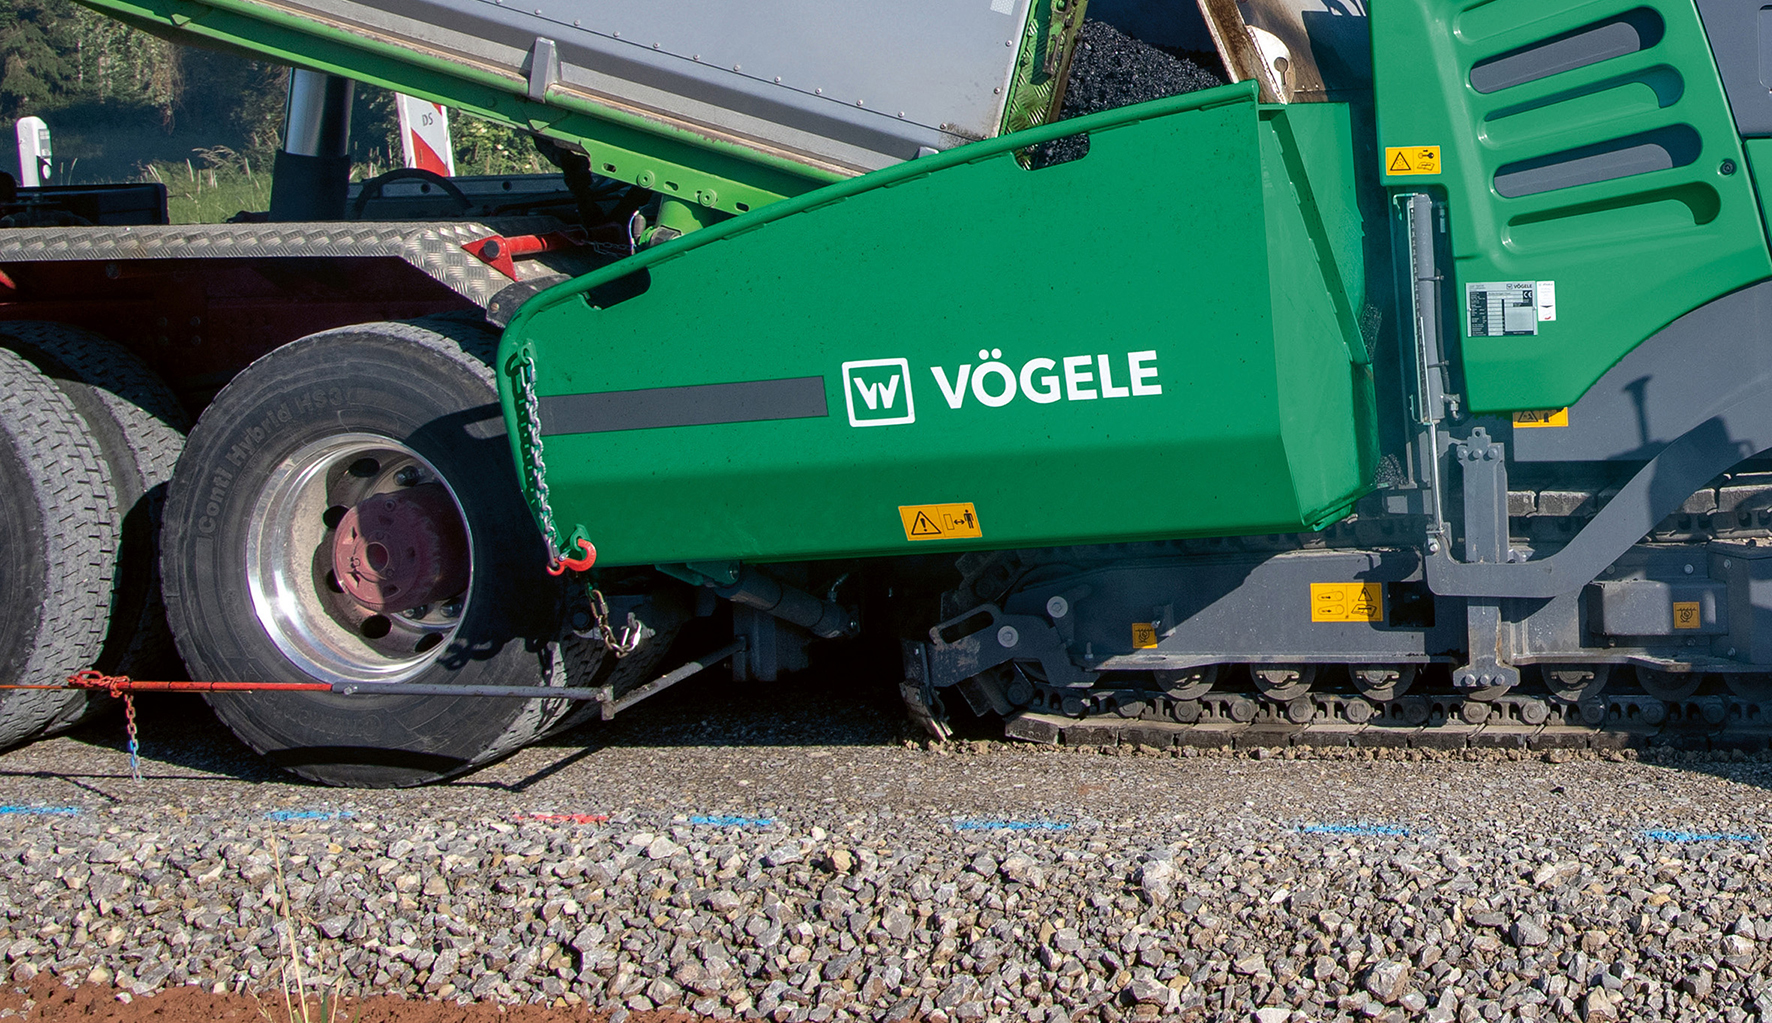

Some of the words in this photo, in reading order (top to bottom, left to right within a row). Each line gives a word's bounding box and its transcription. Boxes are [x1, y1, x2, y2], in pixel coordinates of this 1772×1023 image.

[421, 112, 434, 127] DS
[930, 348, 1163, 410] VÖGELE
[198, 466, 233, 534] Conti
[225, 402, 293, 467] Hybrid
